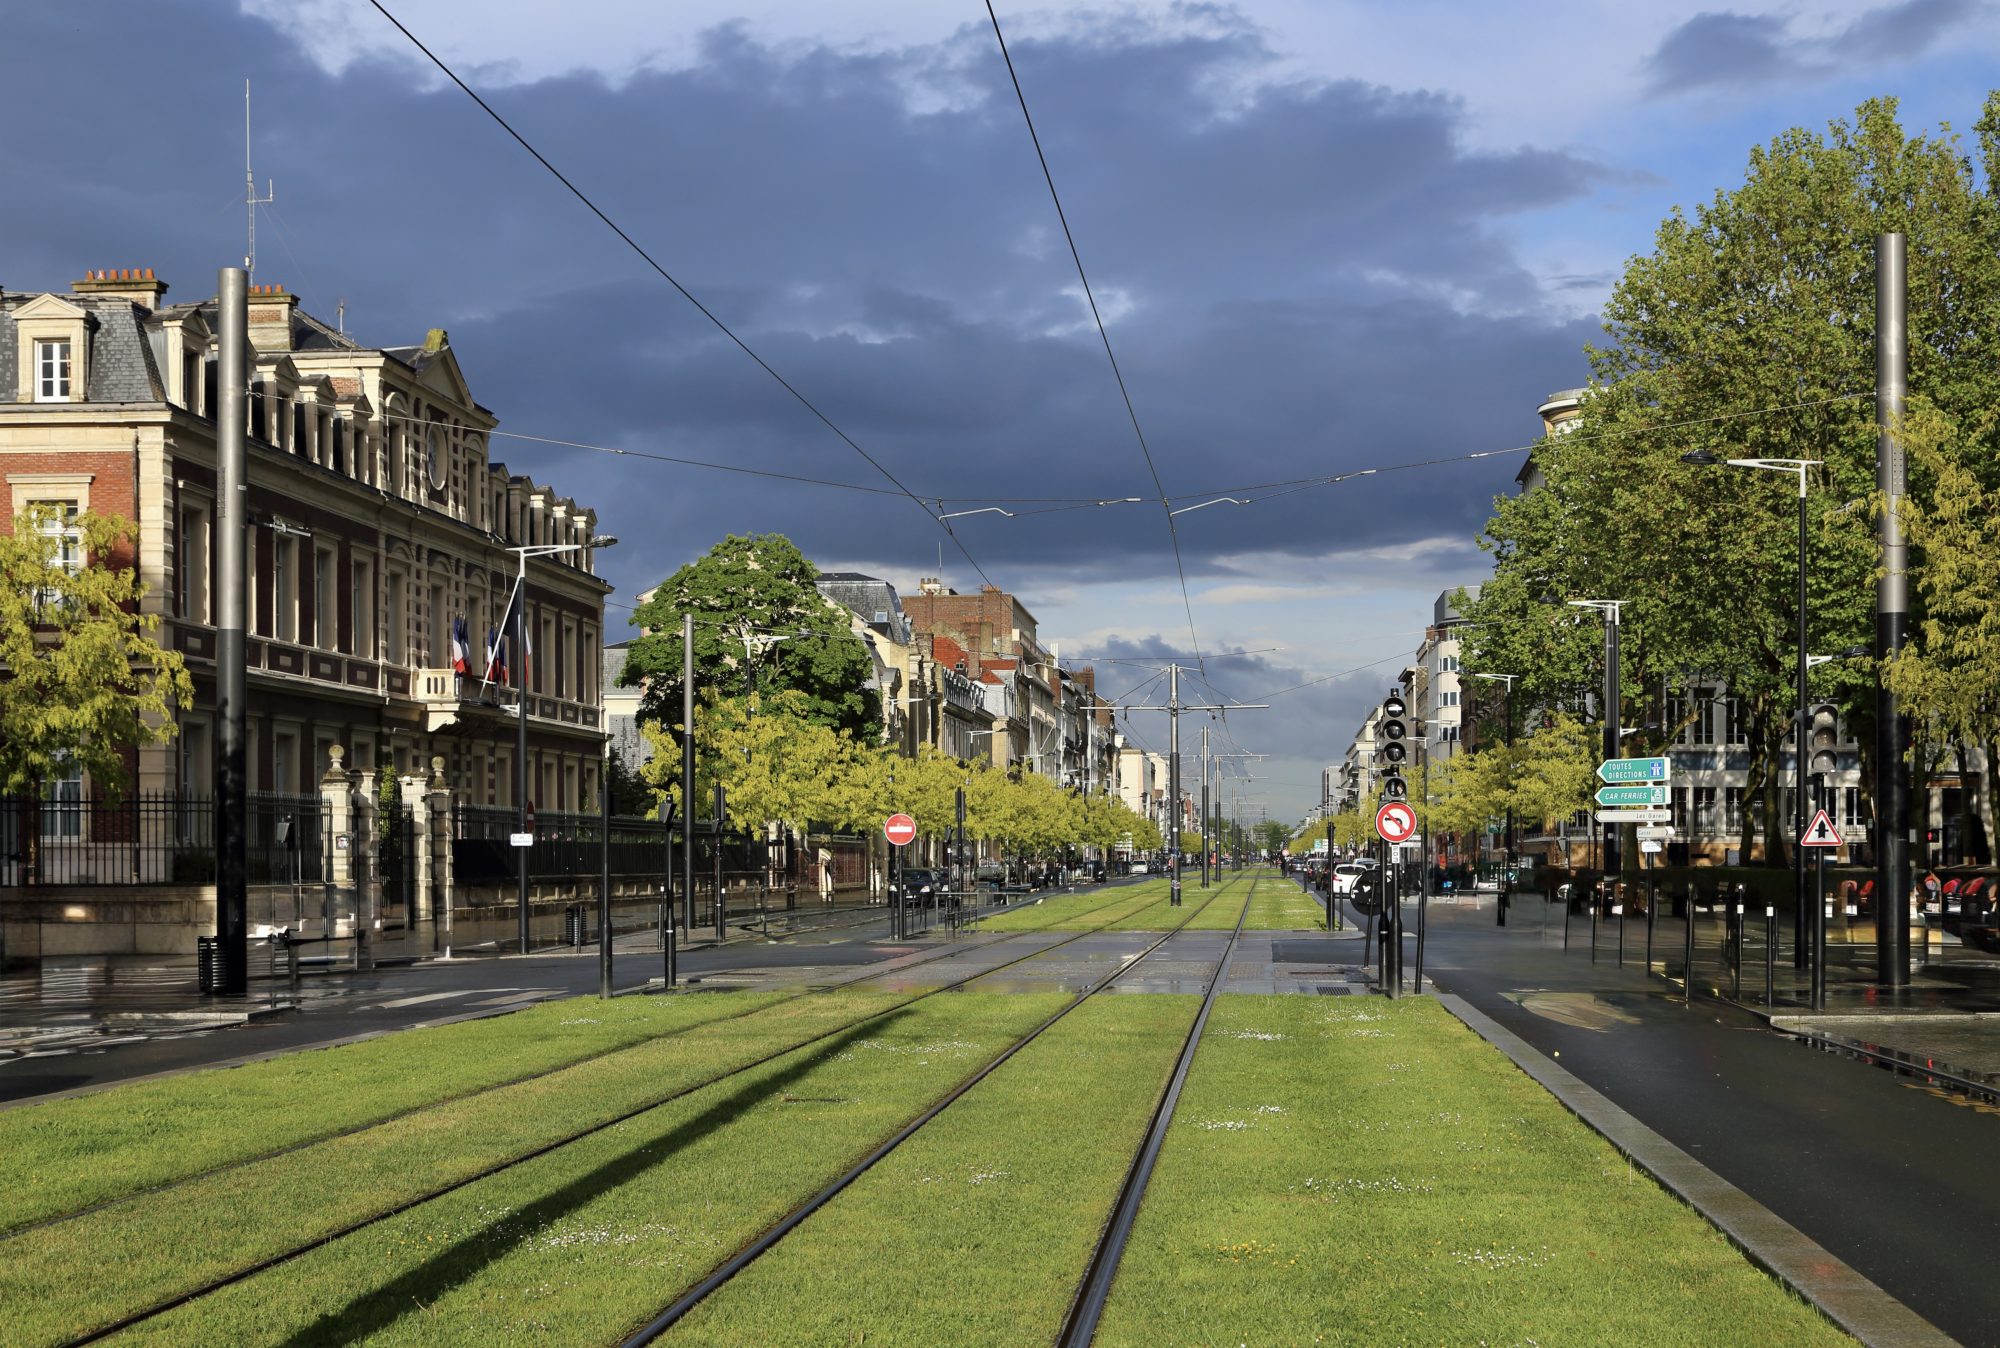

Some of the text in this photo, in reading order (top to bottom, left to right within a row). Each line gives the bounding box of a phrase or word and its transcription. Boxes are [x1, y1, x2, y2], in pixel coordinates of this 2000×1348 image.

[1609, 762, 1632, 770] TOUTES
[1608, 771, 1647, 779] DIRECTIONS
[1605, 791, 1648, 800] CAR FERRIES
